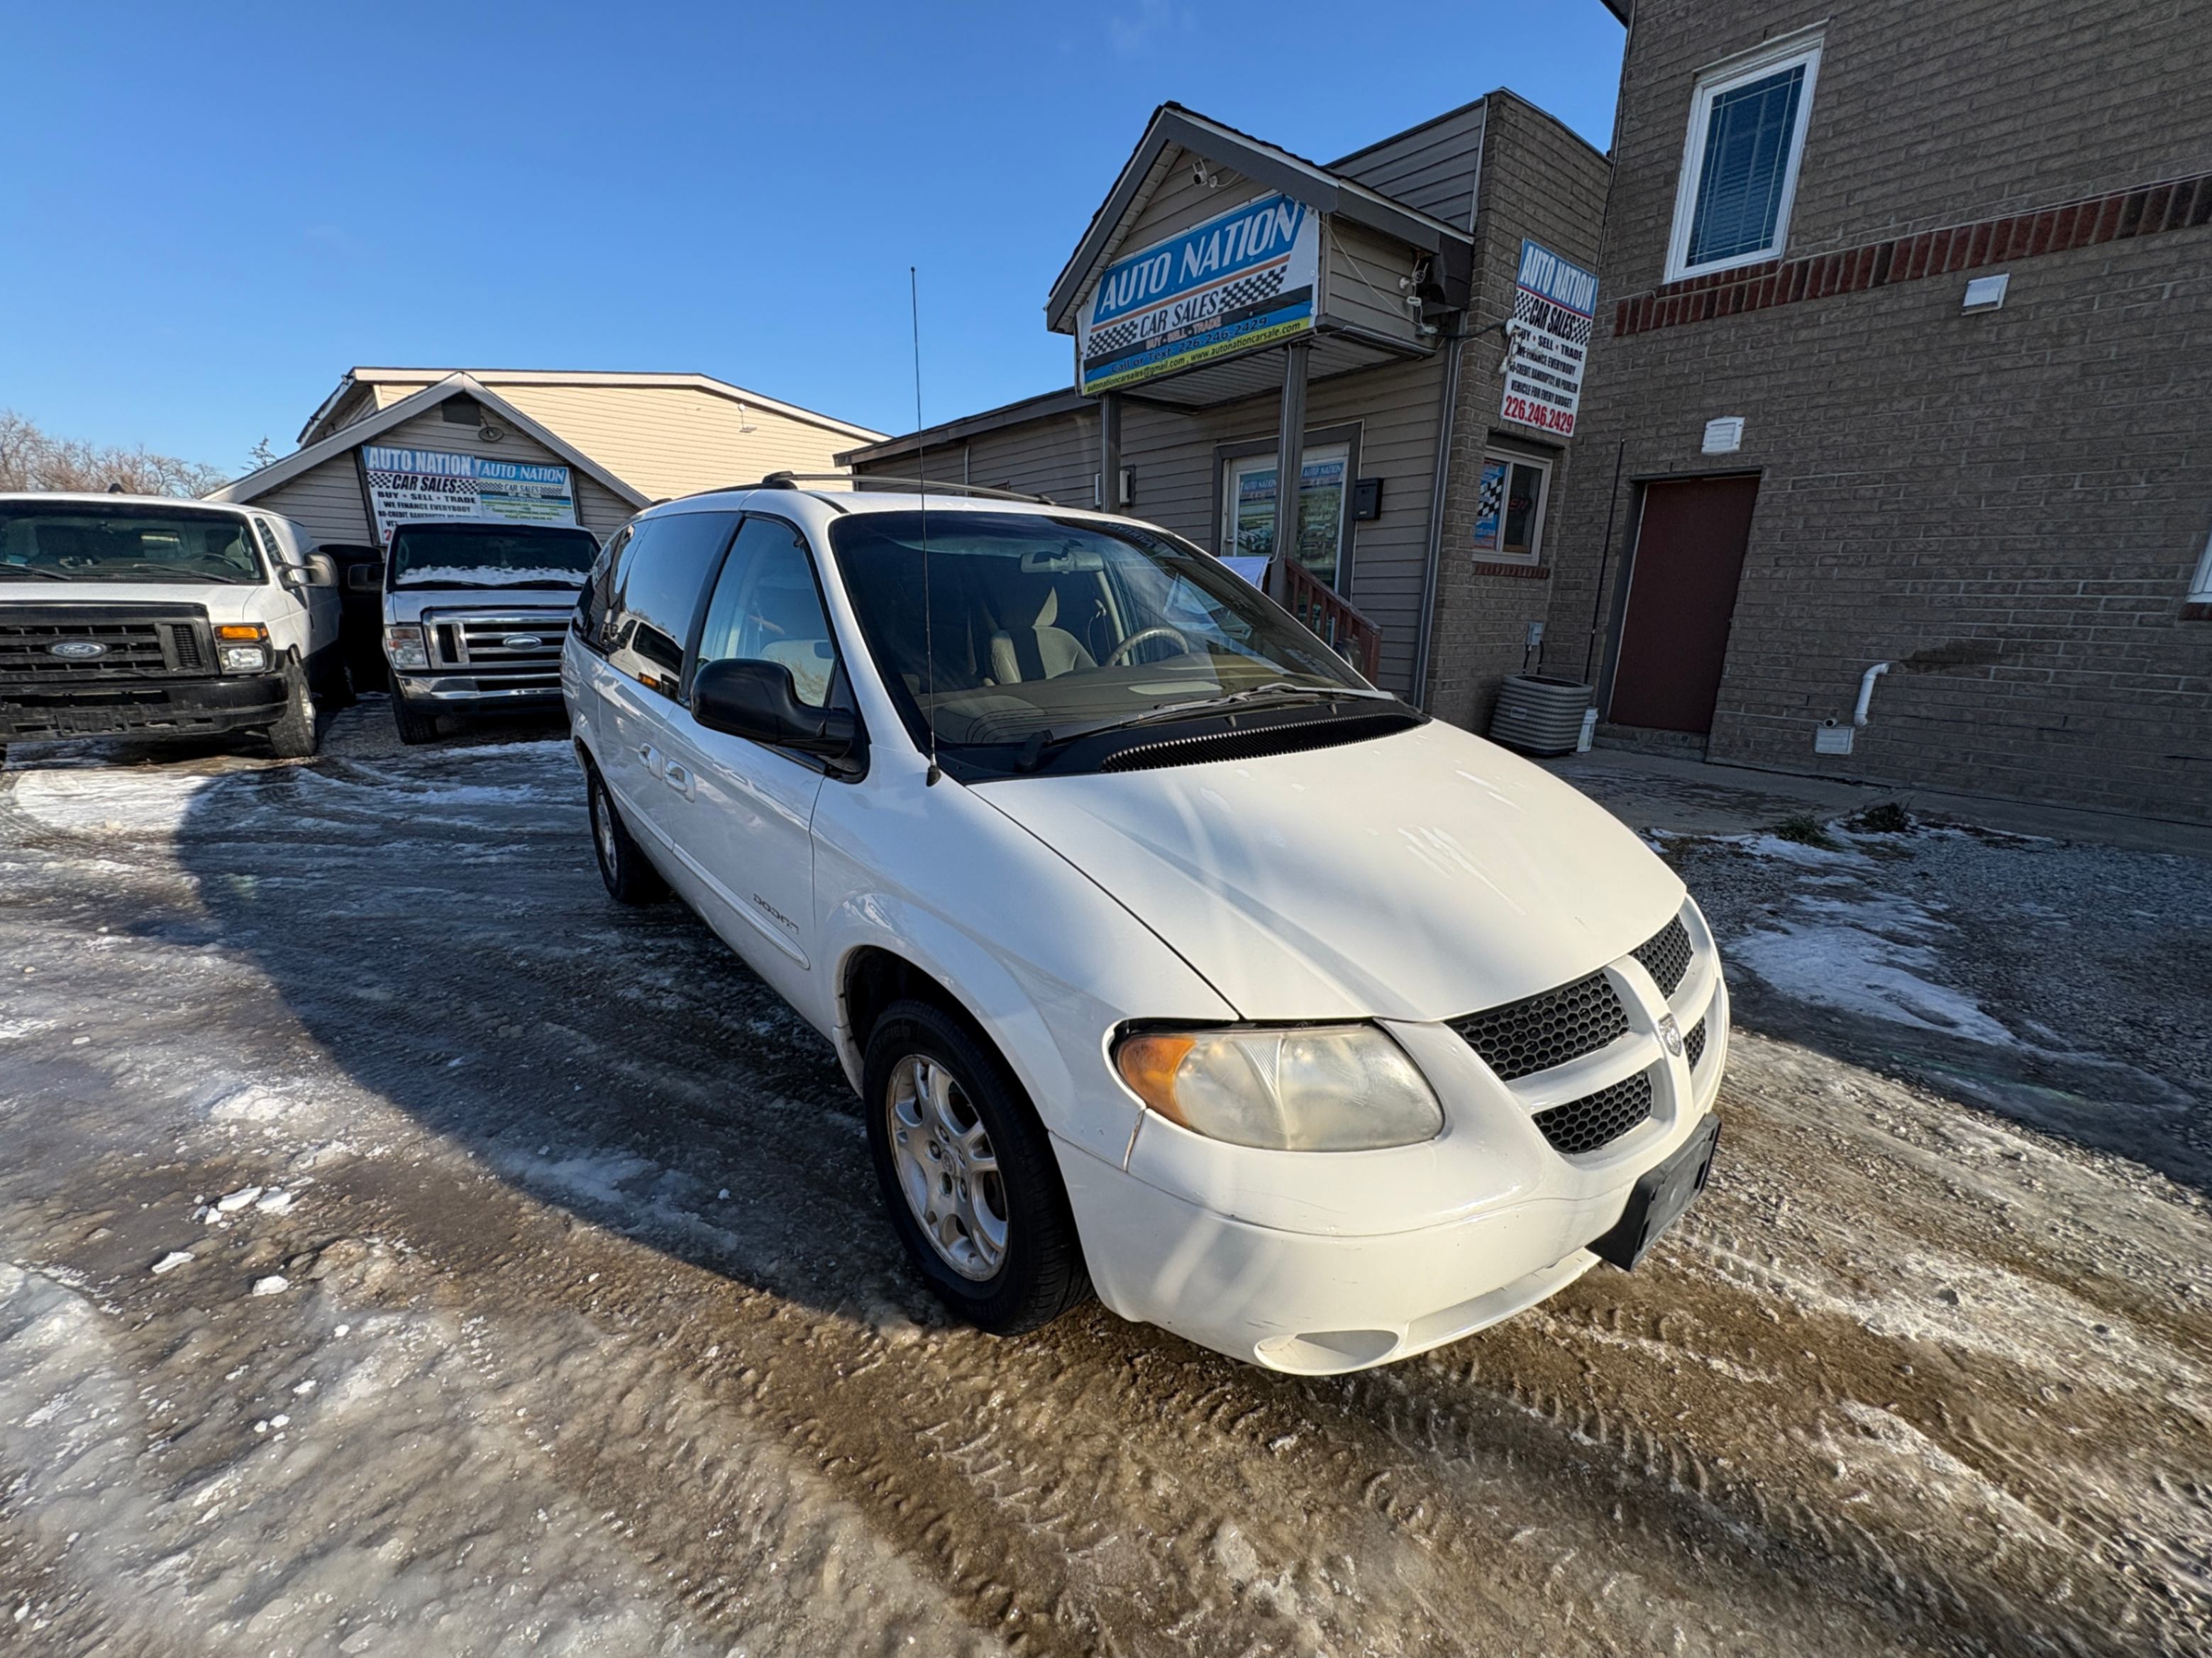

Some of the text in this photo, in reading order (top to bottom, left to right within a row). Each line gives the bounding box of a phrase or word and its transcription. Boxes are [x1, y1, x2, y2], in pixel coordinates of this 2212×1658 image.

[1100, 201, 1299, 314] AUTO NATION
[1520, 245, 1595, 312] AUTO NATION
[1140, 291, 1220, 338] CAR SALES
[1529, 298, 1577, 341] CAR SALES
[1112, 359, 1130, 374] Call
[1133, 357, 1144, 366] or
[1179, 317, 1268, 353] 226-246-2429
[1146, 336, 1162, 350] BUY
[1193, 316, 1222, 334] TRADE
[1190, 321, 1301, 361] www.autonationcarsale.com
[1538, 335, 1554, 351] SELL
[1561, 344, 1583, 362] TRADE
[1547, 356, 1576, 376] EVERYBODY
[1510, 379, 1532, 396] VEHICLE
[1531, 385, 1542, 399] FOR
[1554, 394, 1574, 409] BUDGET
[1504, 394, 1574, 434] 226.246.2429
[368, 447, 472, 476] AUTO NATION
[481, 463, 565, 482] AUTO NATION
[392, 473, 458, 494] CAR SALES
[410, 492, 434, 502] SELL
[444, 495, 477, 504] TRADE
[504, 483, 540, 493] CAR SALES
[397, 501, 428, 511] FINANCE
[429, 504, 471, 513] EVERYBODY
